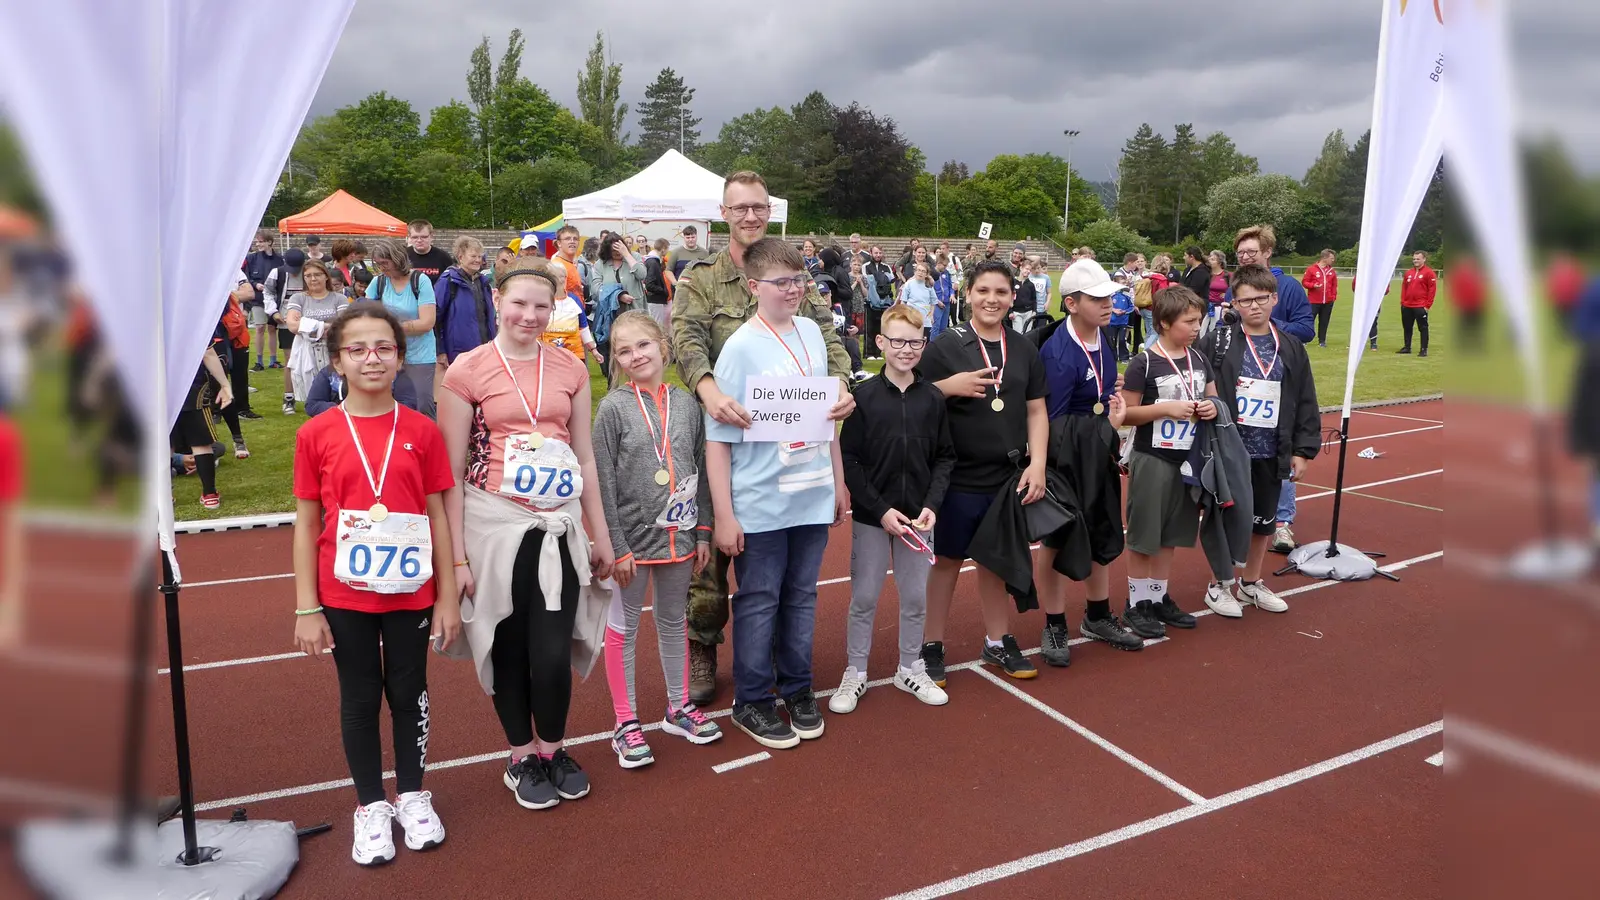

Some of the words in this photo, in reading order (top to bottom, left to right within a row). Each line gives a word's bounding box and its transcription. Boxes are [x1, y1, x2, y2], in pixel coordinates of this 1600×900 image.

[1429, 52, 1443, 82] Beh
[981, 226, 989, 236] 5
[753, 388, 775, 400] Die
[780, 388, 827, 401] Wilden
[751, 409, 801, 425] Zwerge
[1236, 396, 1274, 419] 075
[514, 464, 574, 498] 078
[348, 544, 421, 579] 076
